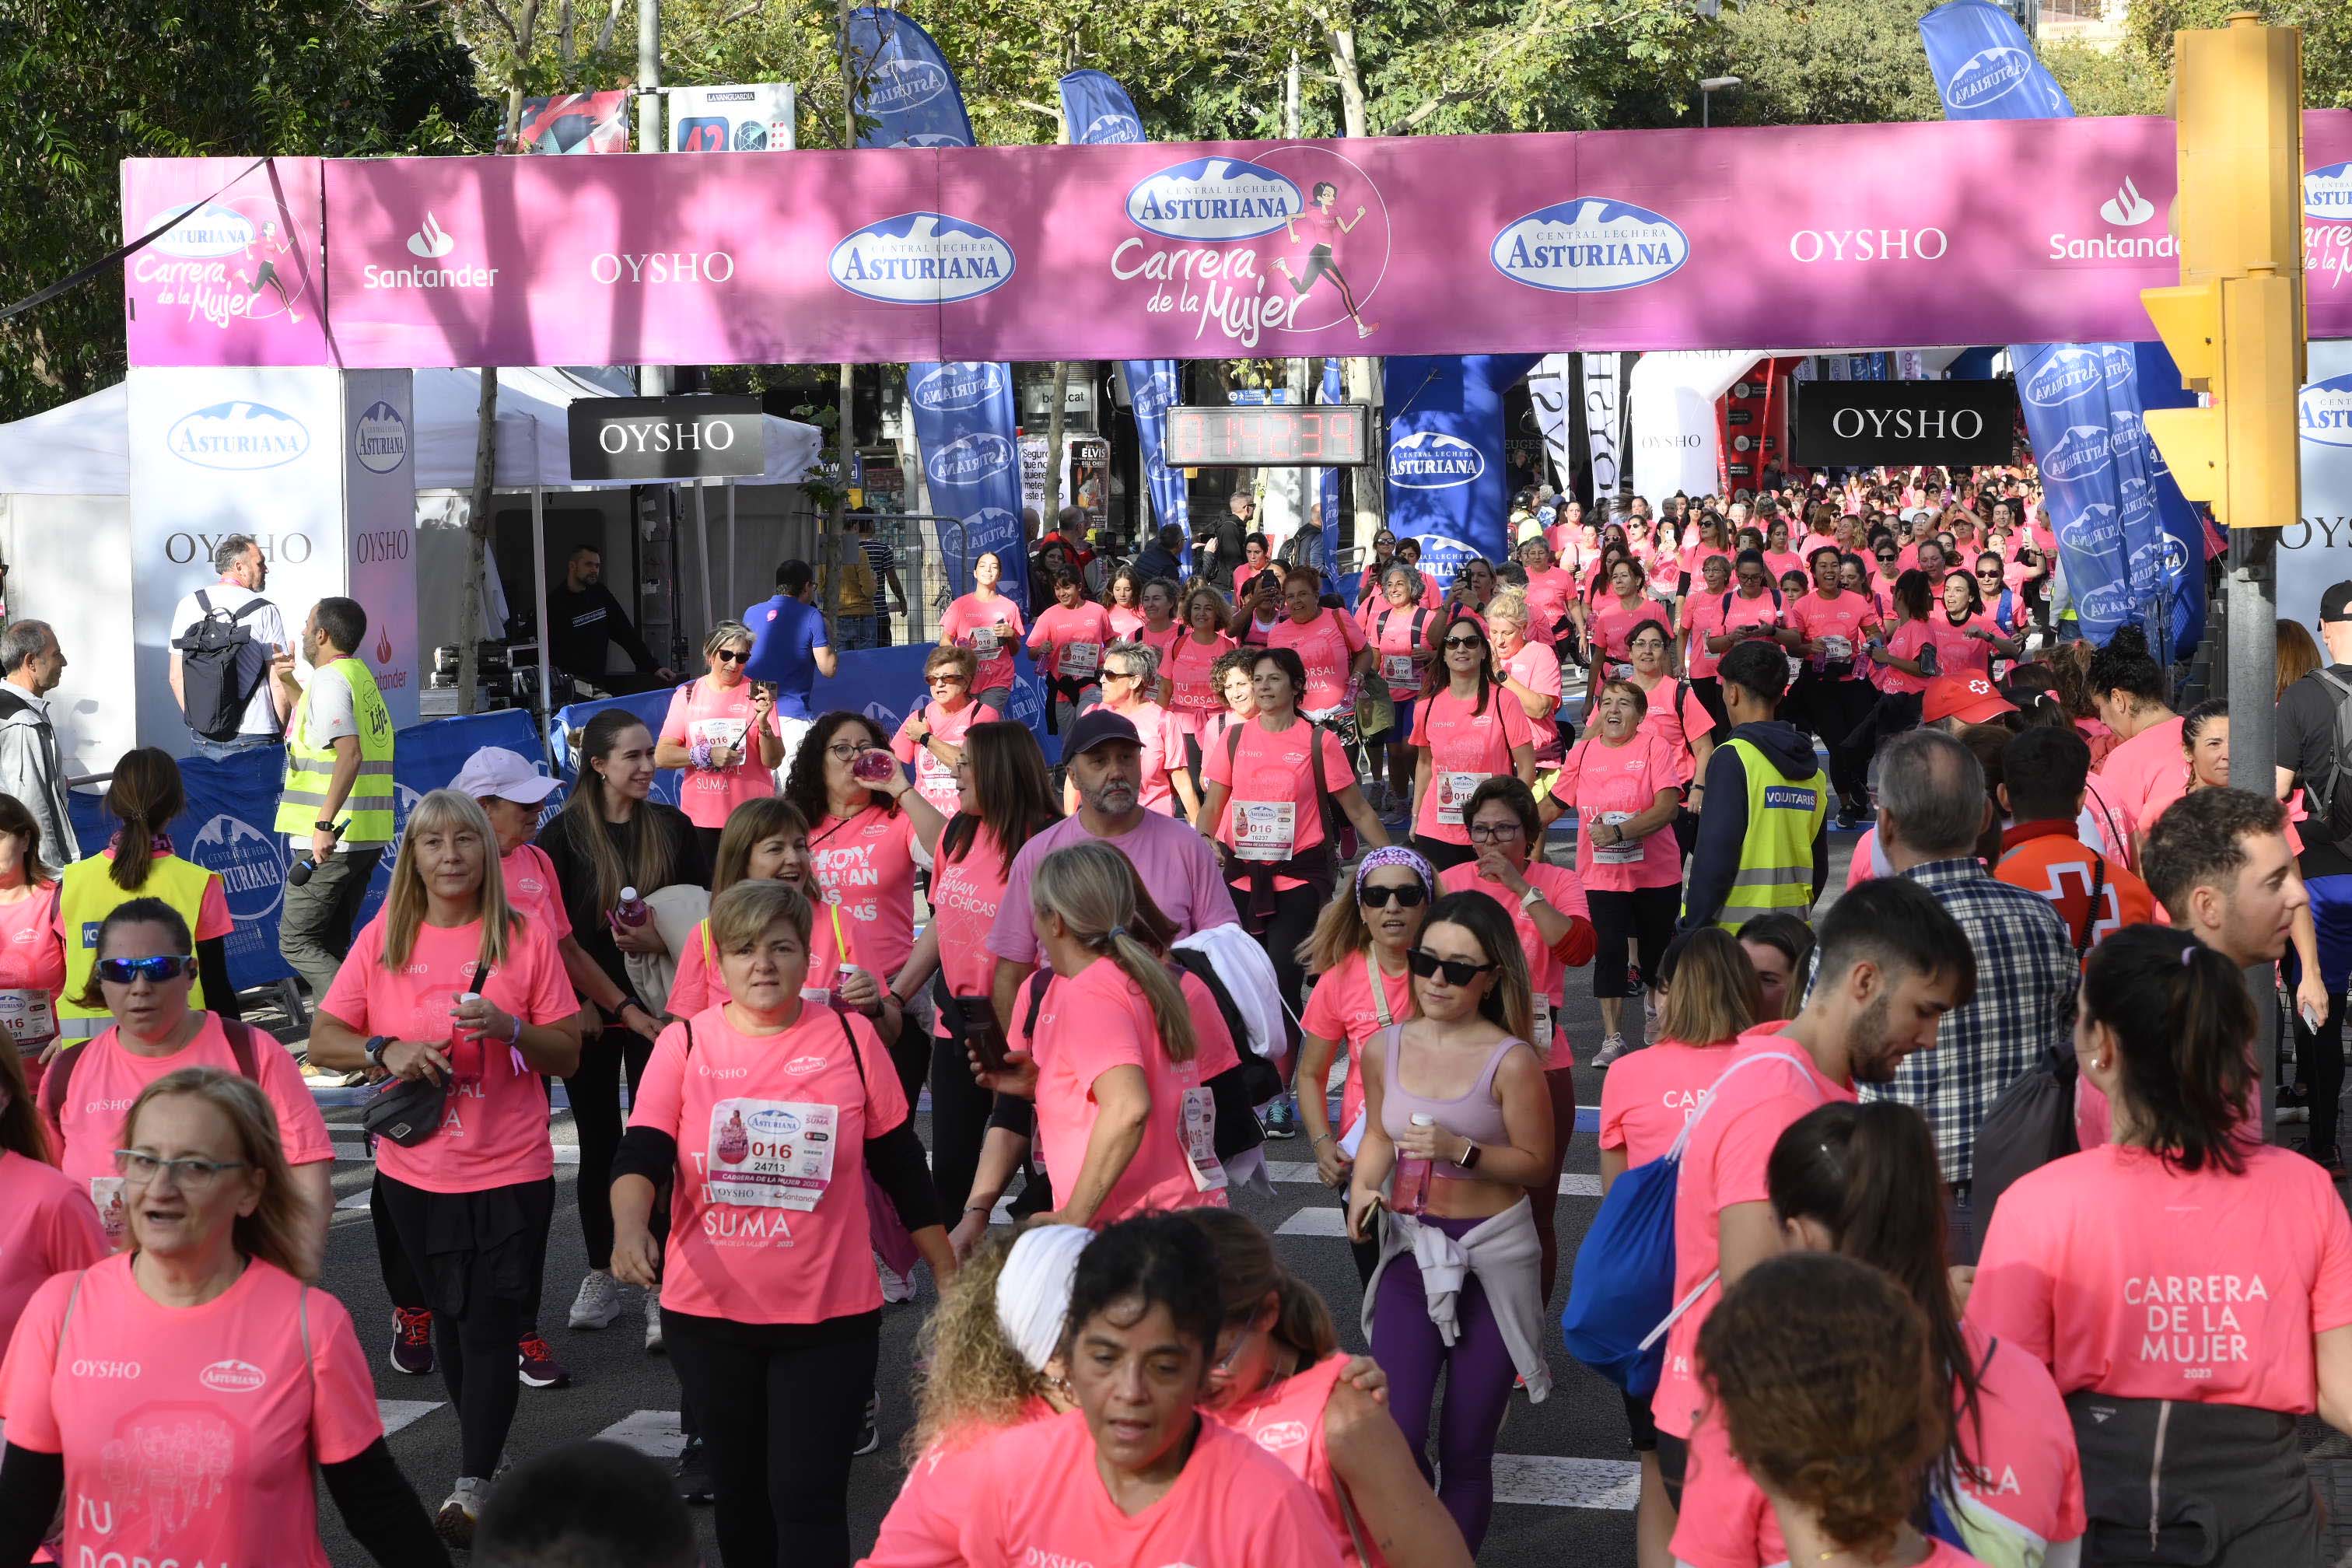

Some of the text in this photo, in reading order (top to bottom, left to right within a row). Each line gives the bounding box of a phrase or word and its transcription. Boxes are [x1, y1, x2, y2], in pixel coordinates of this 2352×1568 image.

[1167, 185, 1284, 195] CENTRAL LECHERA
[1139, 190, 1288, 221] ASTURIANA
[1536, 229, 1667, 240] CENTRAL LECHERA
[1790, 227, 1948, 262] OYSHO
[871, 242, 995, 253] CENTRAL LECHERA
[1506, 234, 1673, 268] ASTURIANA
[2049, 233, 2182, 260] Santand
[135, 254, 226, 283] Carrera
[591, 251, 734, 284] OYSHO
[843, 247, 1001, 281] ASTURIANA
[1111, 237, 1256, 281] Carrera
[363, 265, 499, 289] Santander
[157, 287, 176, 305] de
[188, 281, 261, 329] Mujer
[1147, 275, 1312, 348] de la Mujer
[1832, 408, 1983, 439] OYSHO
[179, 427, 300, 453] ASTURIANA
[359, 429, 404, 456] ASTURIANA
[600, 420, 734, 454] OYSHO
[1082, 448, 1105, 458] ELVIS
[1024, 470, 1048, 479] quiere
[1389, 454, 1478, 477] ASTURIANA
[357, 529, 408, 564] OYSHO
[1177, 682, 1188, 691] TU
[1179, 695, 1217, 705] DORSAL
[369, 704, 388, 735] Life
[710, 736, 728, 745] 016
[697, 778, 730, 790] SUMA
[1582, 805, 1598, 819] TU
[1251, 824, 1272, 833] 016
[945, 865, 968, 879] HOY
[949, 894, 996, 918] CHICAS
[699, 1065, 747, 1080] OYSHO
[86, 1099, 134, 1115] OYSHO
[751, 1117, 797, 1130] ASTURIANA
[1189, 1129, 1203, 1144] 016
[752, 1142, 793, 1159] 016
[754, 1162, 786, 1173] 24713
[722, 1173, 755, 1182] CARRERA
[777, 1178, 800, 1186] MUJER
[718, 1188, 817, 1203] OYSHO Santande
[705, 1210, 792, 1237] SUMA
[2124, 1275, 2269, 1305] CARRERA
[2147, 1305, 2242, 1333] DE LA
[2140, 1335, 2249, 1363] MUJER
[72, 1359, 141, 1380] OYSHO
[206, 1371, 263, 1387] ASTURIANA
[2183, 1368, 2212, 1379] 2023
